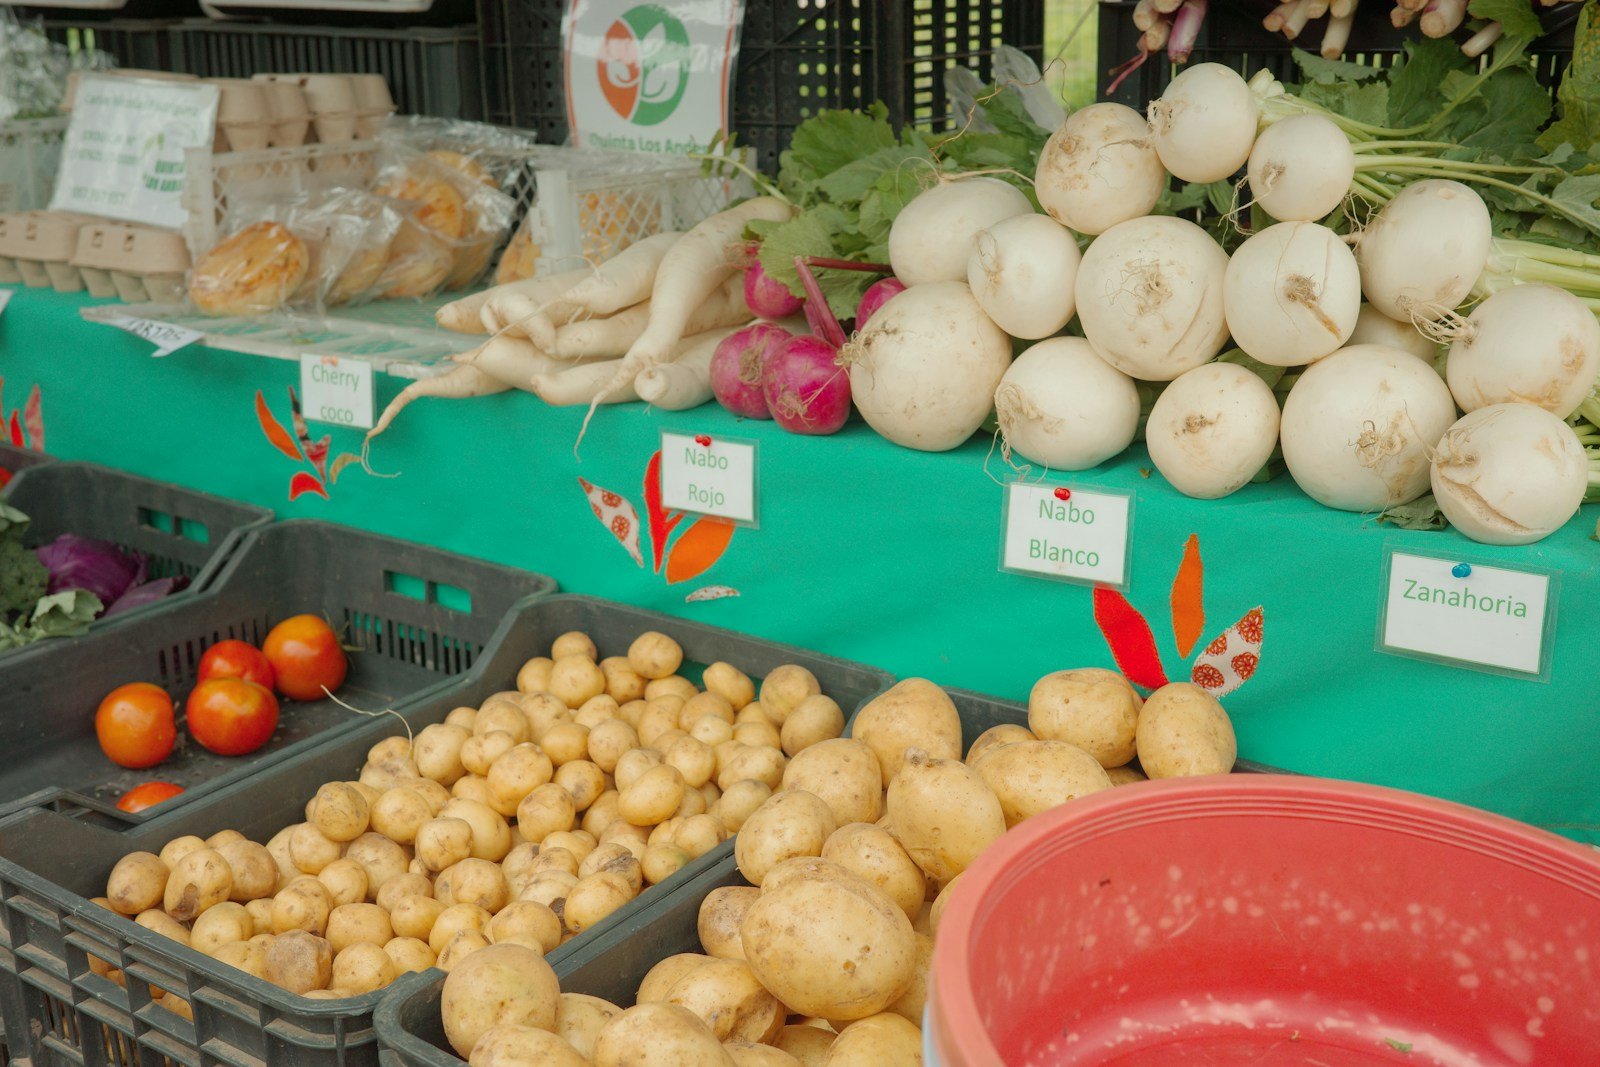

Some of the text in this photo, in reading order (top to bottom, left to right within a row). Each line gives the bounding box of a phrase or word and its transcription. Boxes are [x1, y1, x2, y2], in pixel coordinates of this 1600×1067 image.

[590, 132, 636, 150] Quinta
[639, 137, 662, 153] Los
[311, 364, 360, 391] Cherry
[320, 405, 354, 423] coco
[685, 447, 728, 470] Nabo
[688, 483, 725, 508] Rojo
[1039, 499, 1095, 525] Nabo
[1029, 538, 1099, 567] Blanco
[1403, 578, 1527, 618] Zanahoria
